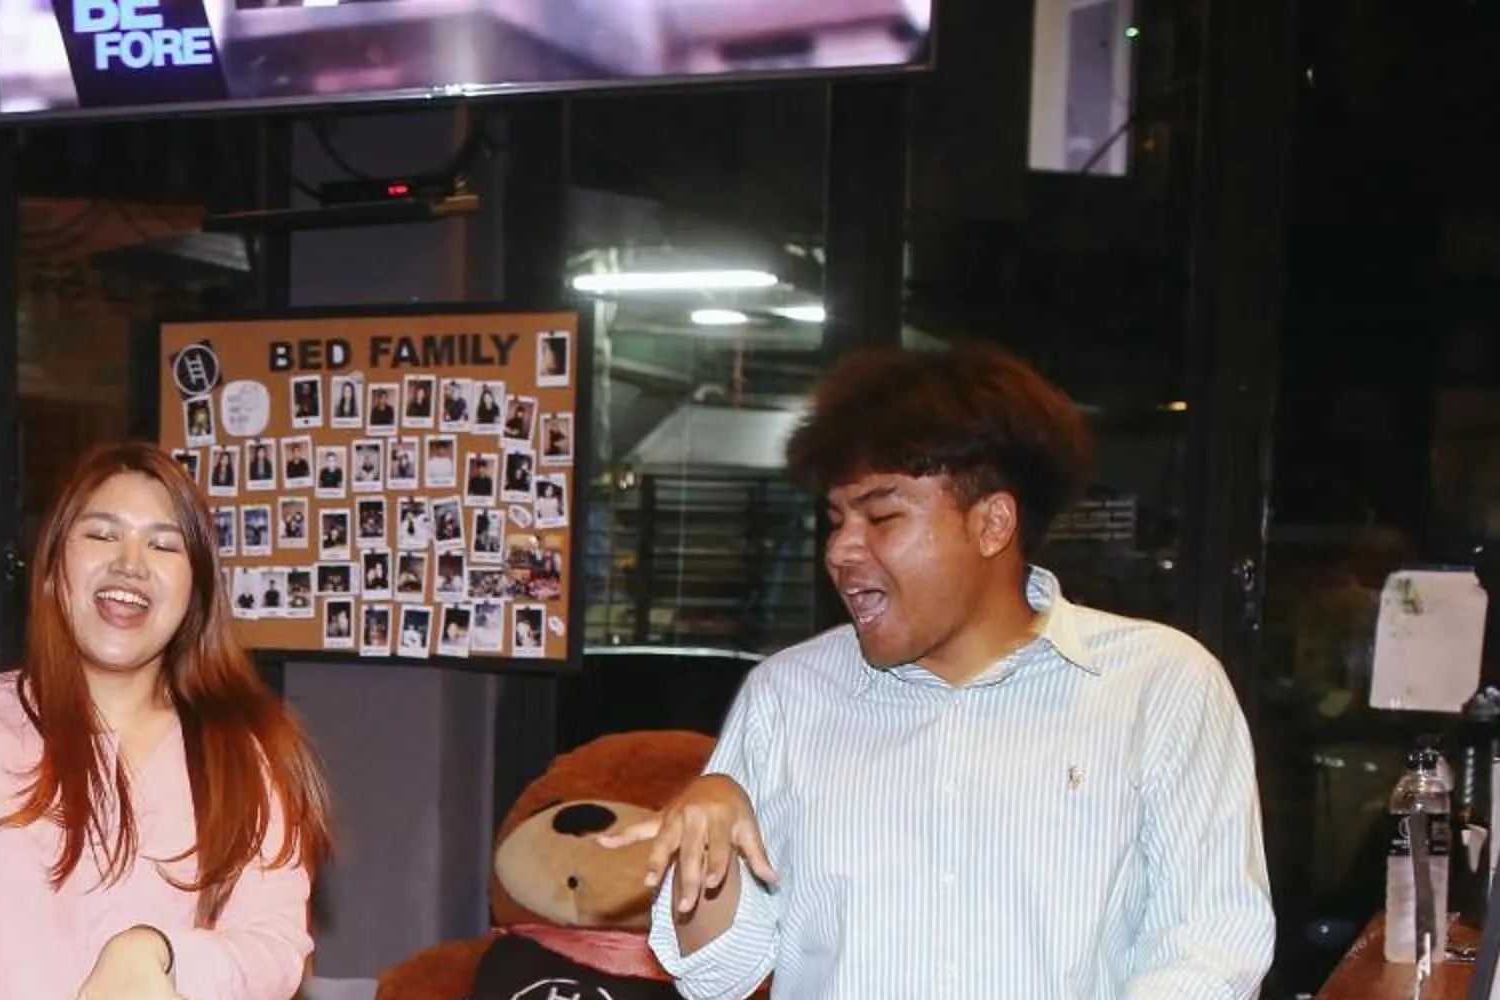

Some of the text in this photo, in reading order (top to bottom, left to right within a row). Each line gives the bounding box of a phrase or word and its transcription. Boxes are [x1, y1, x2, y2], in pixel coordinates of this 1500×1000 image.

[94, 27, 213, 70] FORE
[269, 333, 519, 373] BED FAMILY
